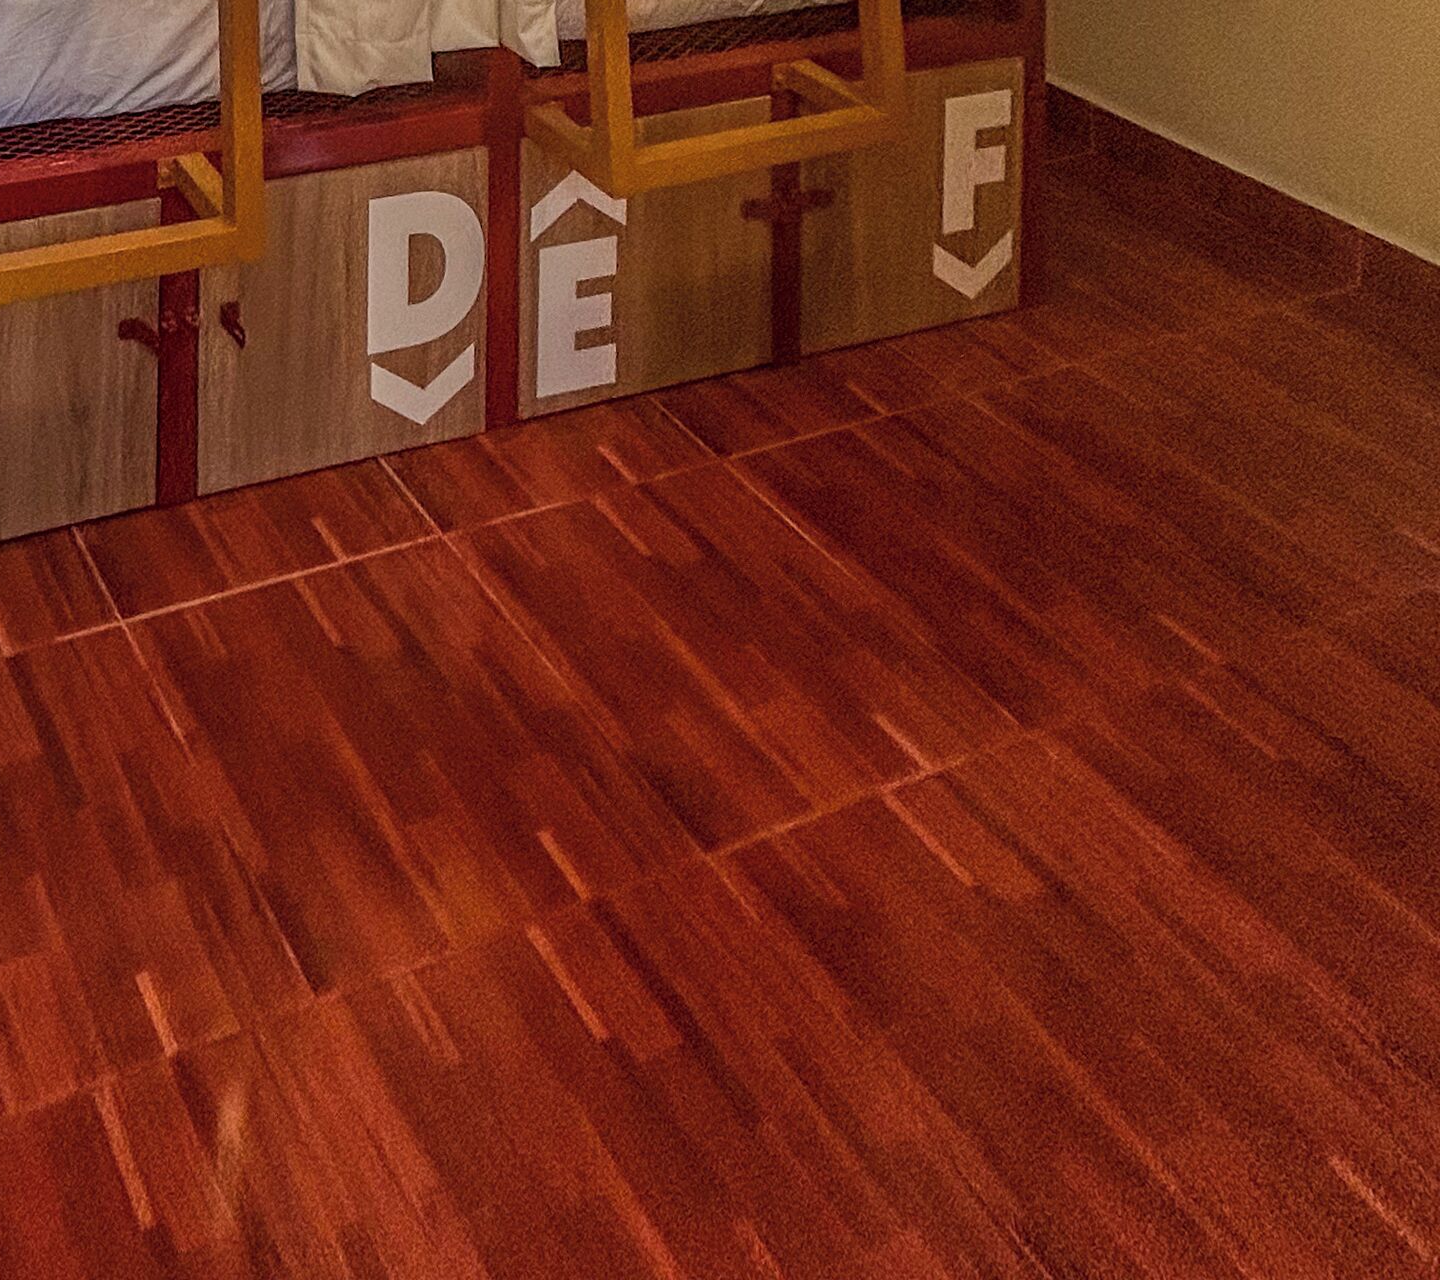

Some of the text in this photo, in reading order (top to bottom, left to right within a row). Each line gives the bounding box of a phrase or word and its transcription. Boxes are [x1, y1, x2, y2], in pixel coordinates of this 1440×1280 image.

[942, 89, 1012, 235] F
[367, 190, 486, 355] D
[536, 235, 619, 399] E
